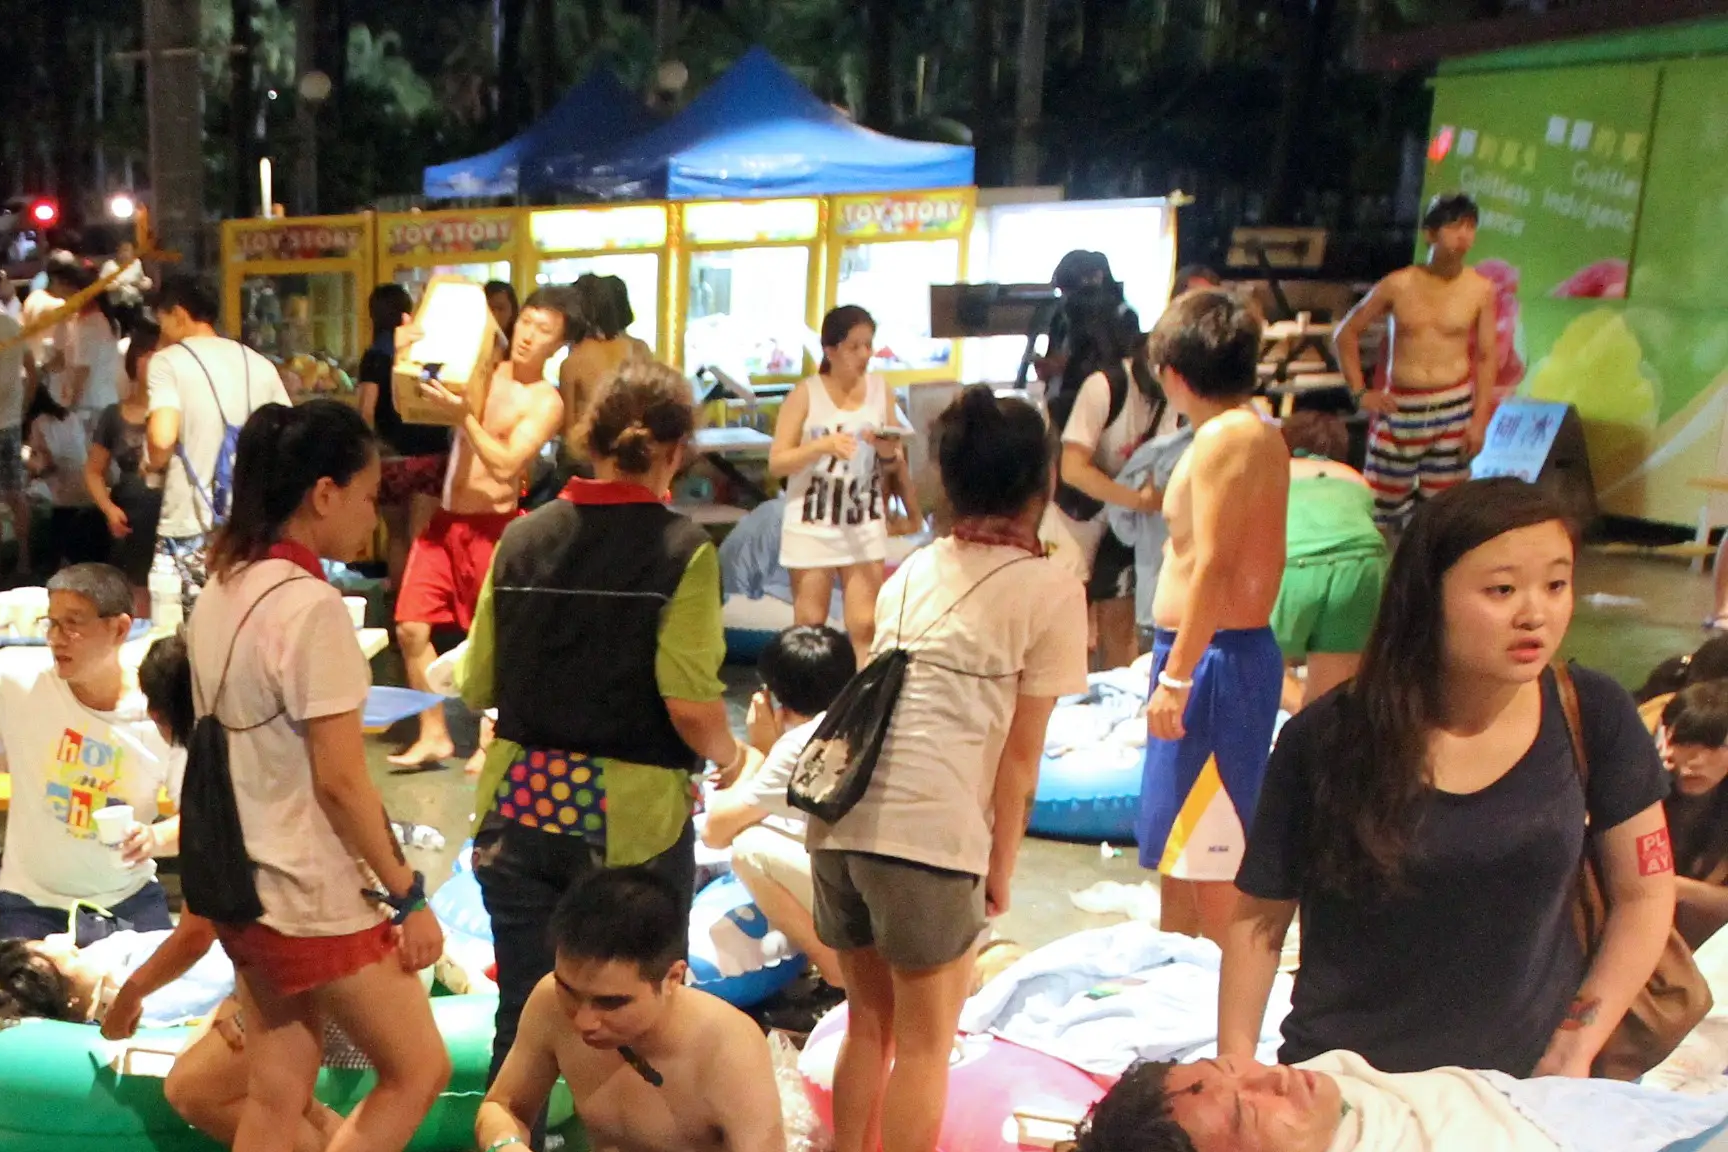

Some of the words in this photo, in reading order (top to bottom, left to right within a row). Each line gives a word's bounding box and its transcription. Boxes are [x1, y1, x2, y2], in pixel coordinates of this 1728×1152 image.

[843, 203, 883, 224] TOY
[890, 199, 962, 222] STORY
[240, 232, 284, 251] TOY
[291, 230, 358, 250] STORY
[393, 223, 436, 244] TOY
[440, 220, 512, 243] STORY
